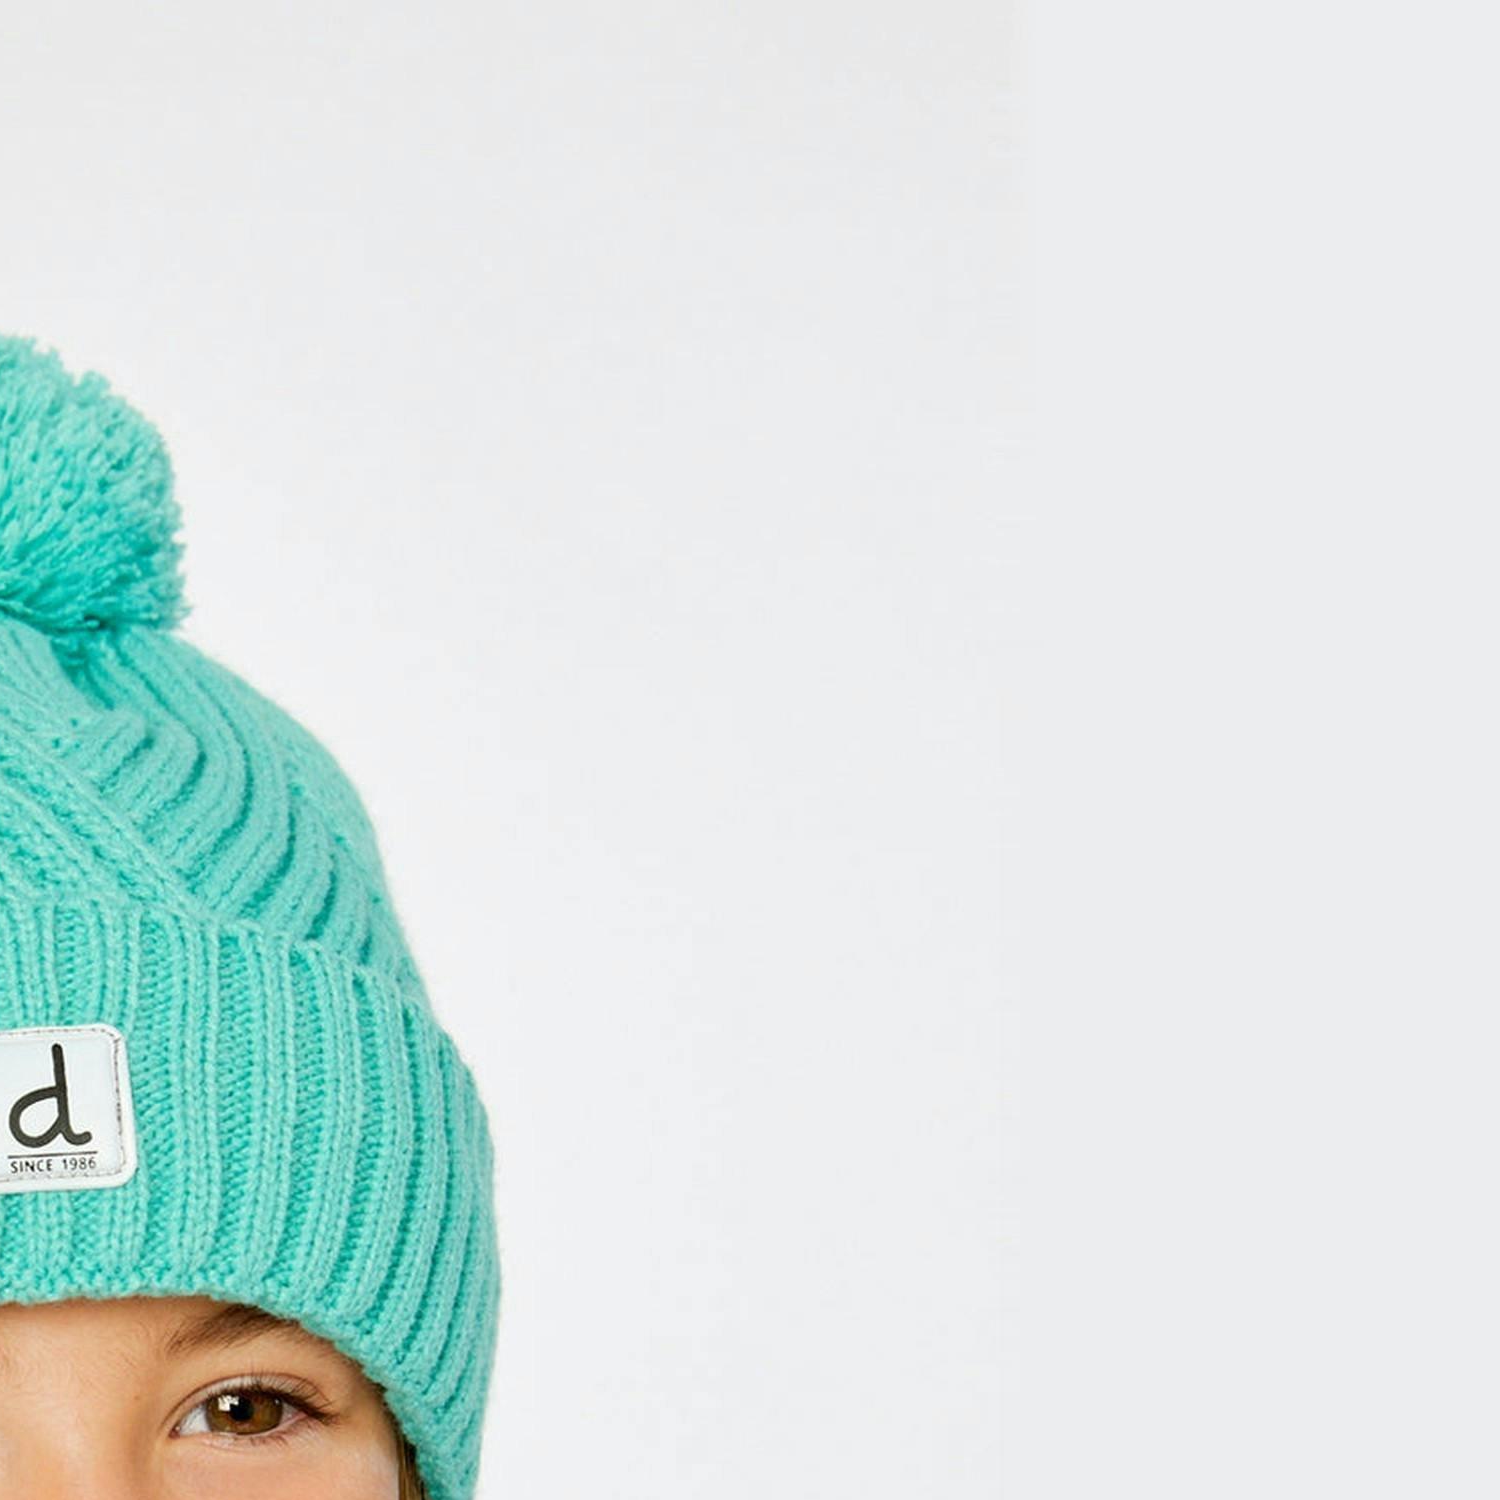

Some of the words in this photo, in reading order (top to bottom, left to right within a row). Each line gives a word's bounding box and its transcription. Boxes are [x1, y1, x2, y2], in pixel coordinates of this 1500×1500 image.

[8, 1043, 92, 1148] d
[10, 1159, 52, 1174] SINCE
[62, 1157, 97, 1171] 1986
